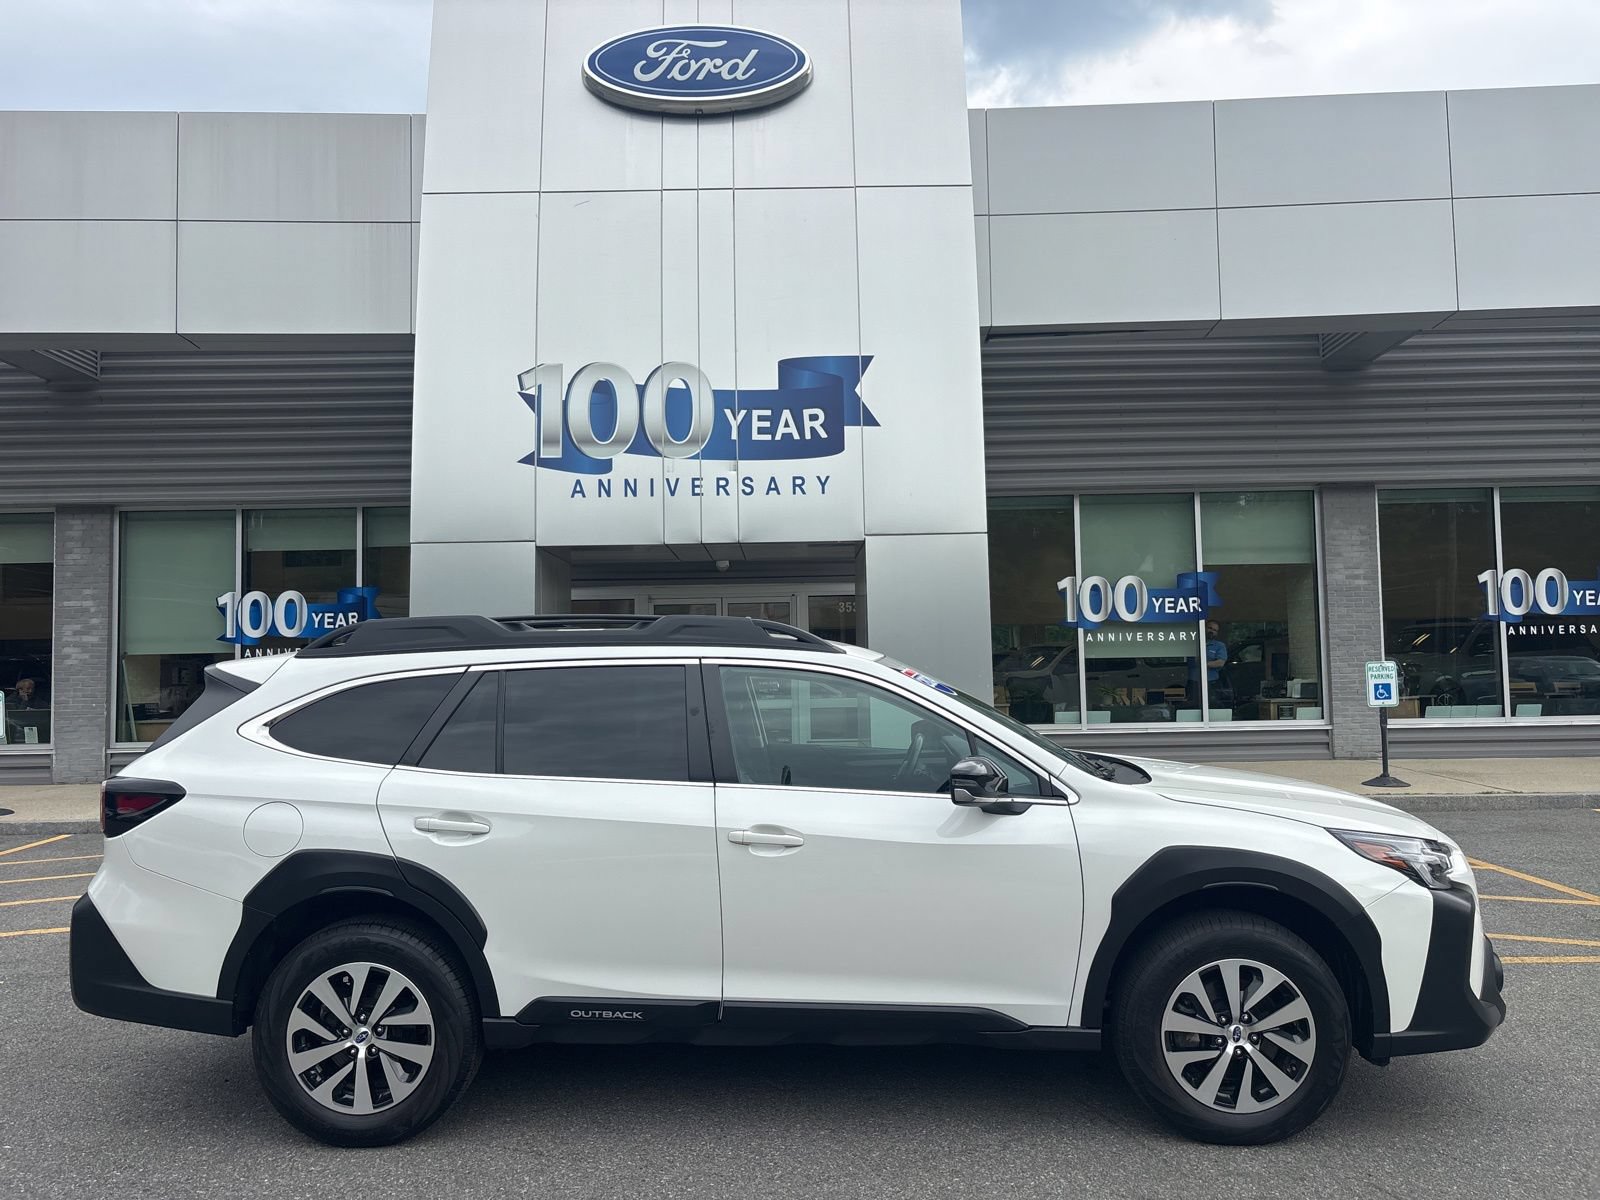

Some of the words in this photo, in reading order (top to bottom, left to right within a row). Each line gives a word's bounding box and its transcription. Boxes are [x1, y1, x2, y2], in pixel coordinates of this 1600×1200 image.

[633, 39, 759, 82] Ford
[517, 361, 715, 460] 100
[724, 408, 828, 441] YEAR
[570, 475, 831, 499] ANNIVERSARY
[217, 590, 308, 638] 100
[312, 612, 359, 628] YEAR
[1056, 575, 1148, 623] 100
[1152, 596, 1202, 614] YEAR
[1477, 567, 1569, 616] 100
[1086, 631, 1197, 642] ANNIVERSARY
[570, 1009, 643, 1019] OUTBACK
